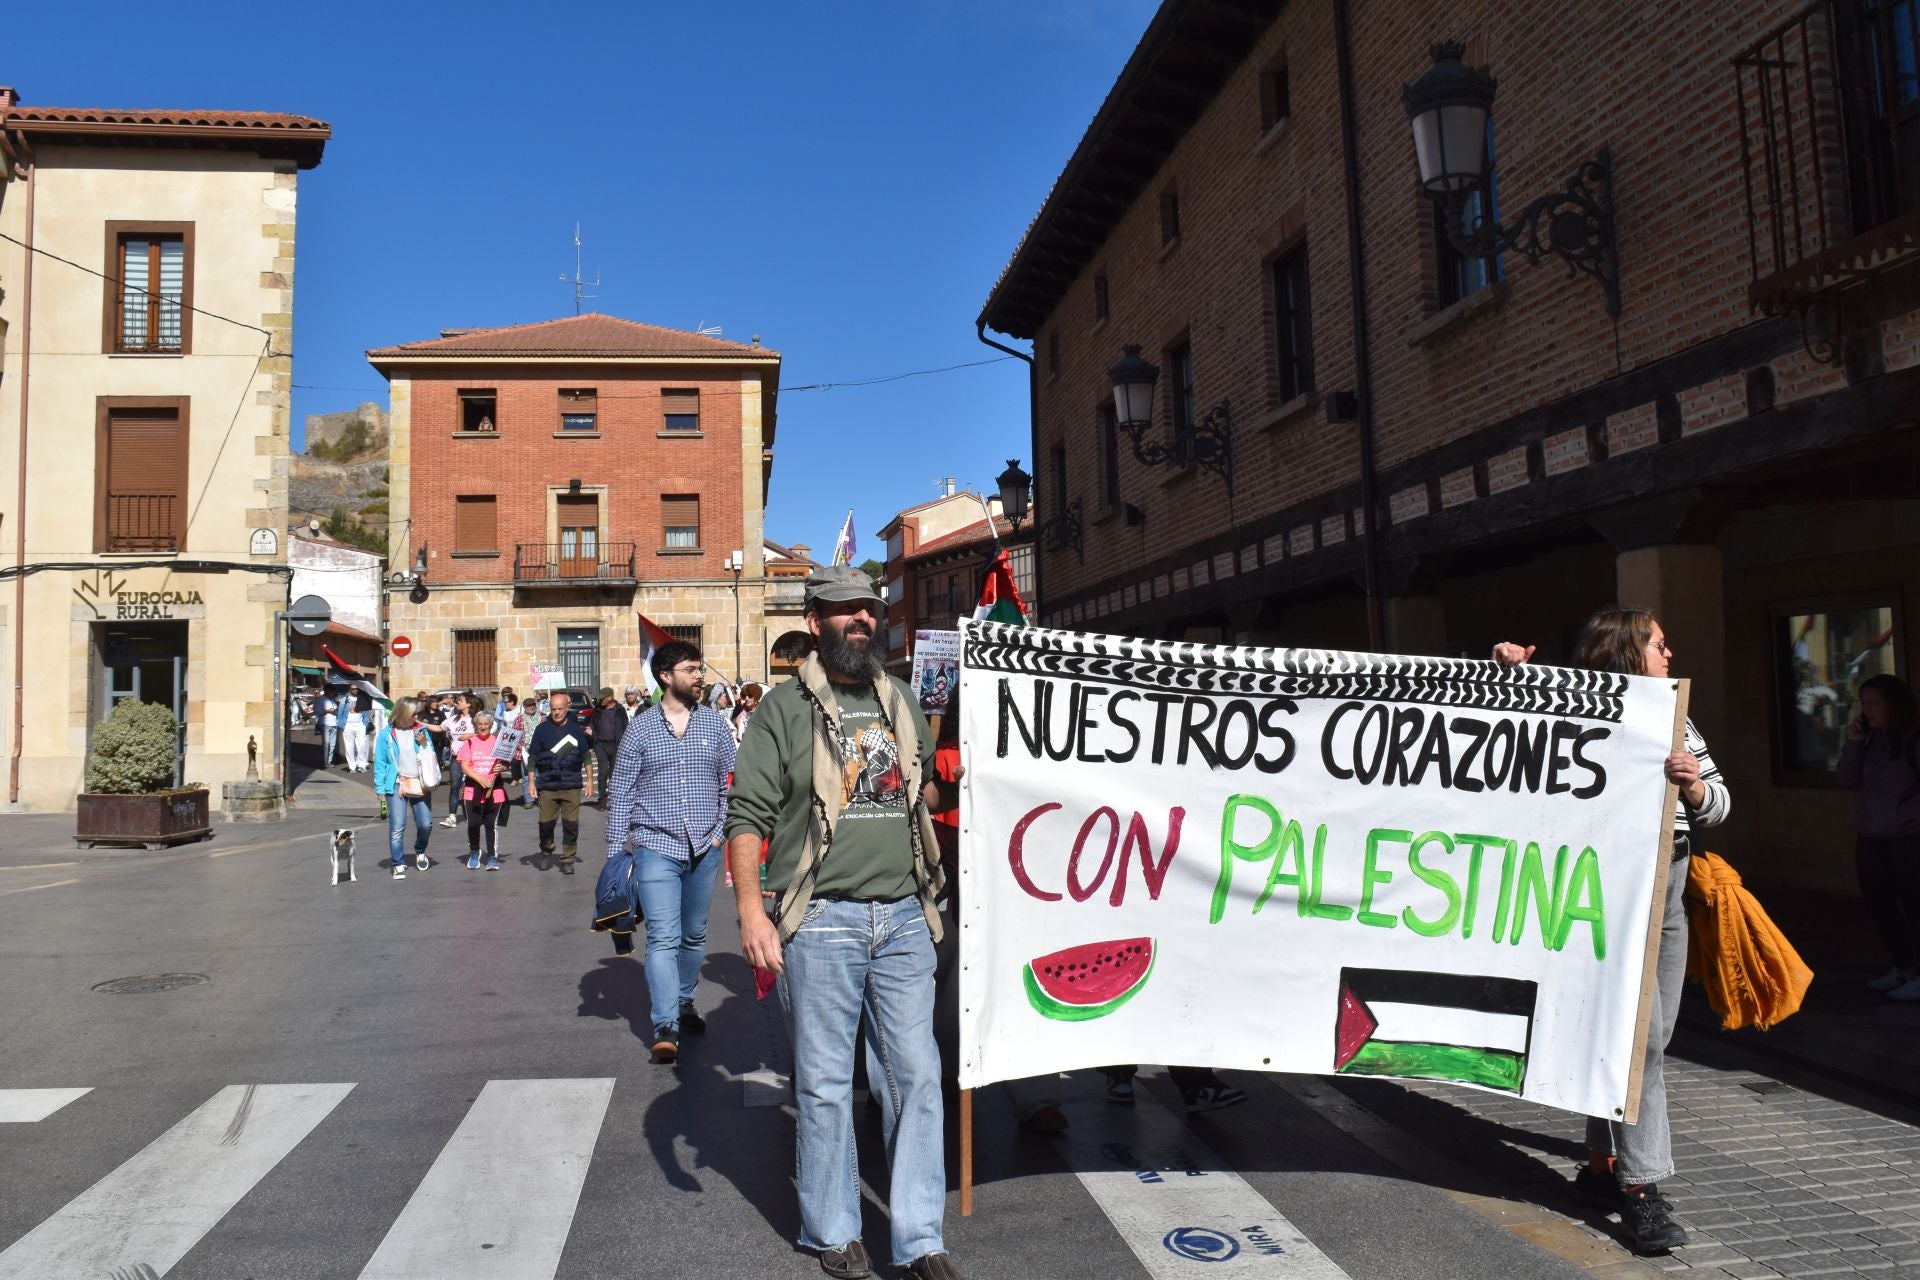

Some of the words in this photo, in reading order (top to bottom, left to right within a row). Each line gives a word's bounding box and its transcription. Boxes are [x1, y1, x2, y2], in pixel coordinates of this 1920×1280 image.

[117, 591, 204, 605] EUROCAJA
[117, 606, 173, 619] RURAL
[997, 677, 1299, 774] NUESTROS
[1321, 701, 1611, 799] CORAZONES
[1008, 802, 1186, 907] CON
[1209, 794, 1606, 960] PALESTINA
[1240, 1225, 1285, 1255] MIRA
